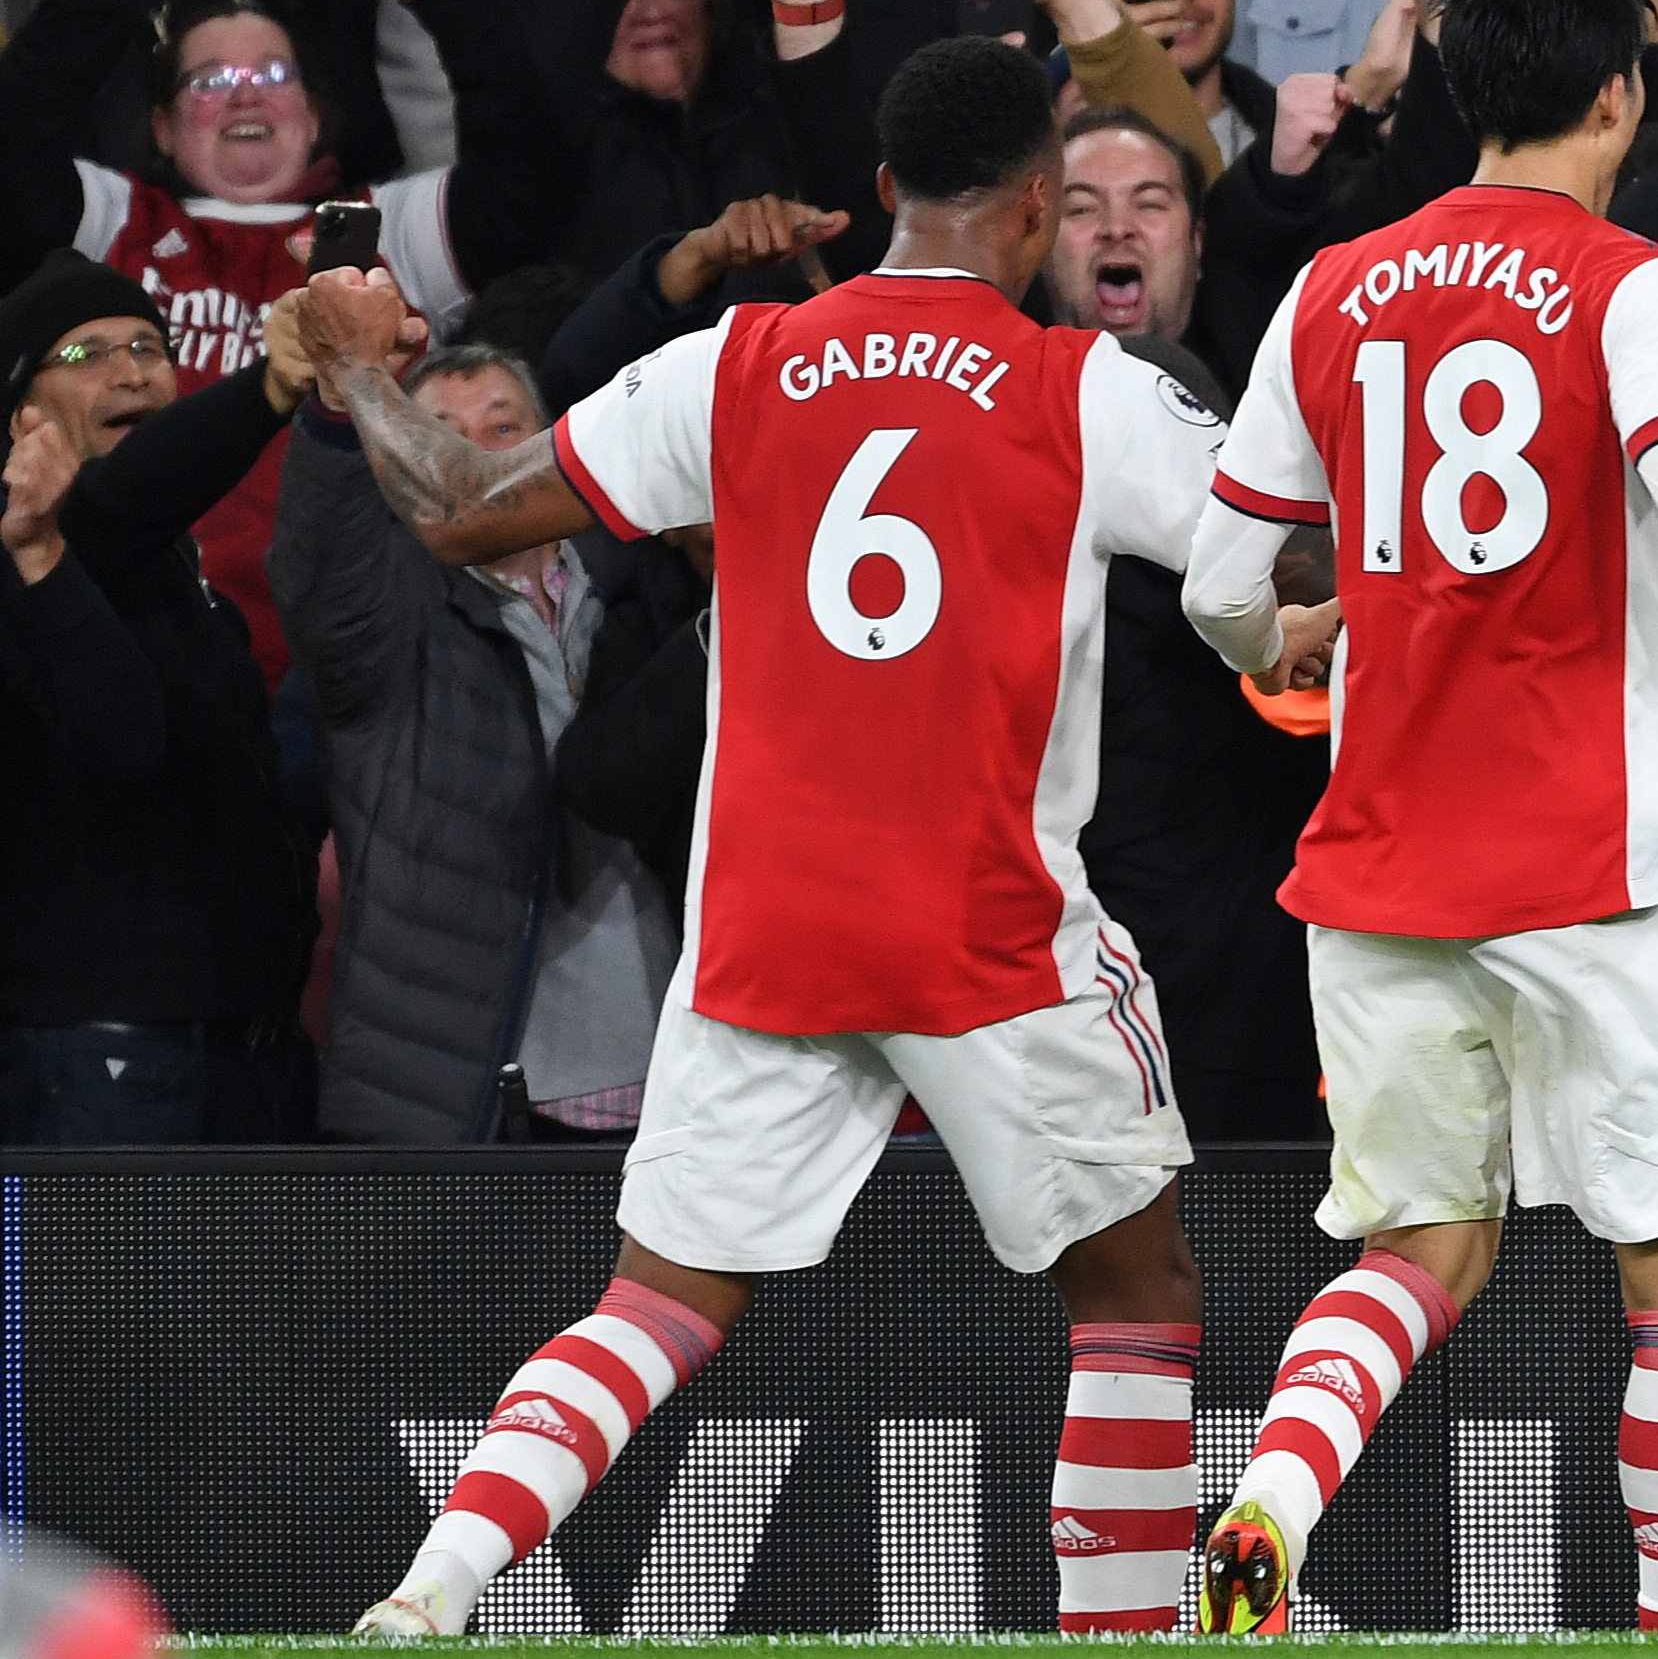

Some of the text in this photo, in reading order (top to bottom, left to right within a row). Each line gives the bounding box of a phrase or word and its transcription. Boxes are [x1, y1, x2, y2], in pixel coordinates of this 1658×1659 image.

[1337, 240, 1574, 335] TOMIYASU
[779, 331, 1011, 411] GABRIEL
[1353, 338, 1550, 575] 18
[806, 428, 942, 660] 6
[1286, 1372, 1366, 1415] adidas
